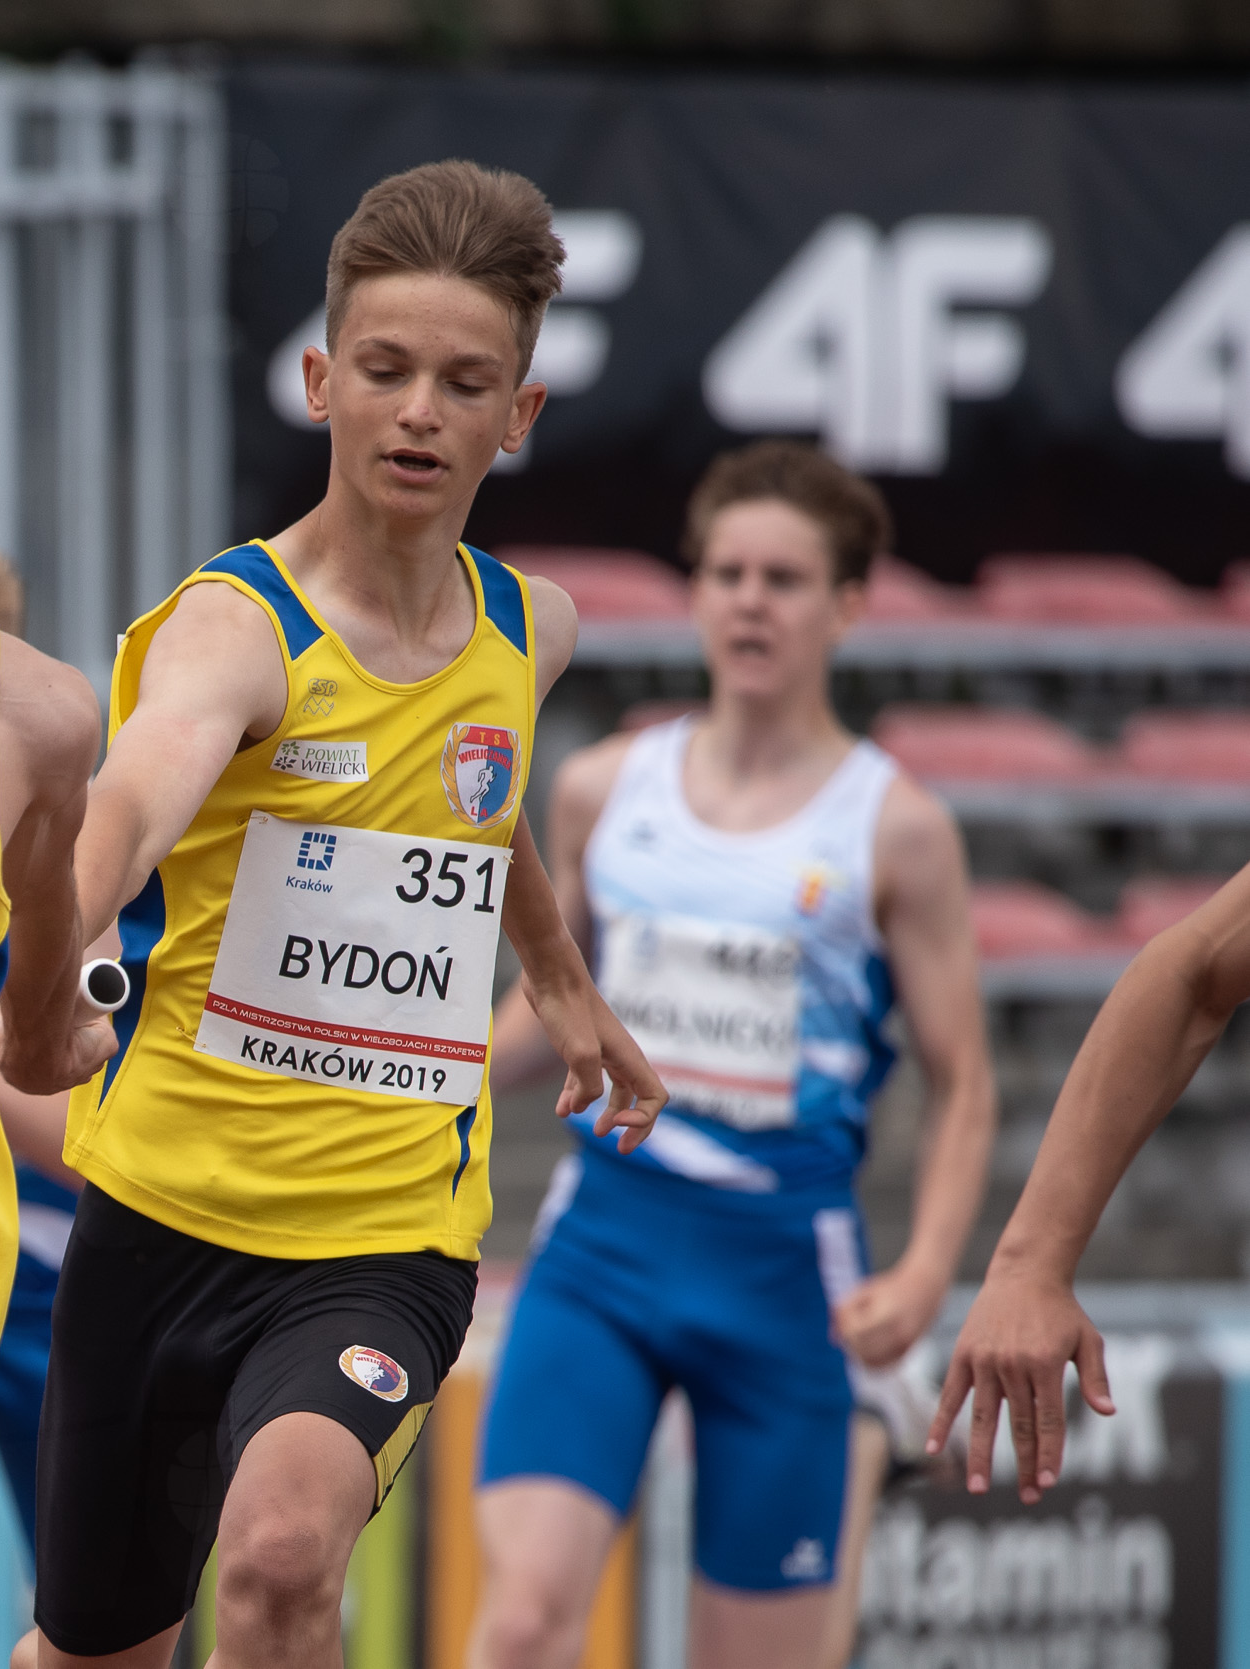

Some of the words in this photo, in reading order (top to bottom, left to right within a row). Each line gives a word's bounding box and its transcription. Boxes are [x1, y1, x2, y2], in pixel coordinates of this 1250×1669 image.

[703, 213, 1053, 476] 4F
[300, 759, 366, 775] WIELICKI
[304, 747, 360, 762] POWIAT
[285, 875, 334, 894] Kraków
[395, 847, 496, 914] 351
[278, 934, 453, 1001] BYDOŃ
[212, 1000, 238, 1015] PZLA
[239, 1008, 312, 1033] MISTRZOSTWA
[313, 1026, 349, 1039] POLSKI
[350, 1032, 361, 1041] W
[362, 1034, 428, 1050] WIELOBOJACH
[433, 1044, 485, 1058] SZTAFETACH
[240, 1034, 374, 1083] KRAKÓW
[379, 1062, 447, 1094] 2019
